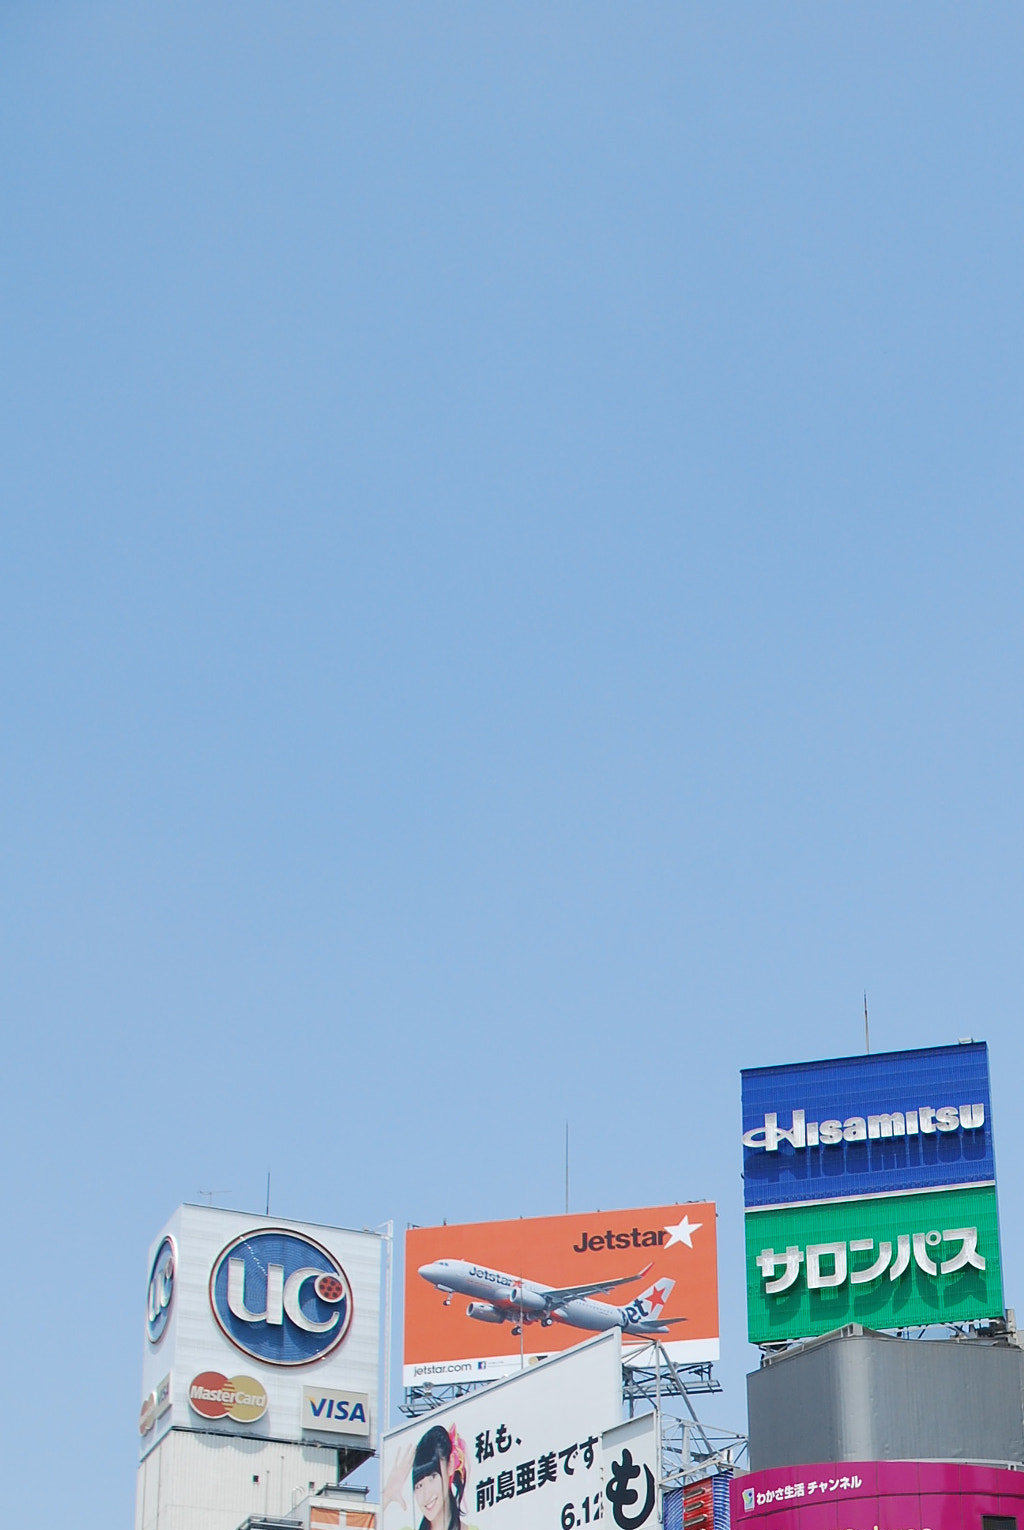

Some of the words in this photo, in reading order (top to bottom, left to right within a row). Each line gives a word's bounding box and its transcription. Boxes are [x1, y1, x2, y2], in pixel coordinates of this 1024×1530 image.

[742, 1103, 985, 1151] Hisamitsu
[573, 1226, 668, 1253] Jetstar
[756, 1226, 986, 1294] サロンパス
[468, 1265, 513, 1287] Jetstar
[413, 1361, 472, 1377] jetstar.com
[190, 1384, 267, 1408] MasterCard
[309, 1397, 367, 1424] VISA
[475, 1423, 522, 1464] 私も、
[476, 1436, 599, 1513] 前島亜美です
[756, 1483, 804, 1505] わかさ生活
[808, 1475, 862, 1495] チャンネル
